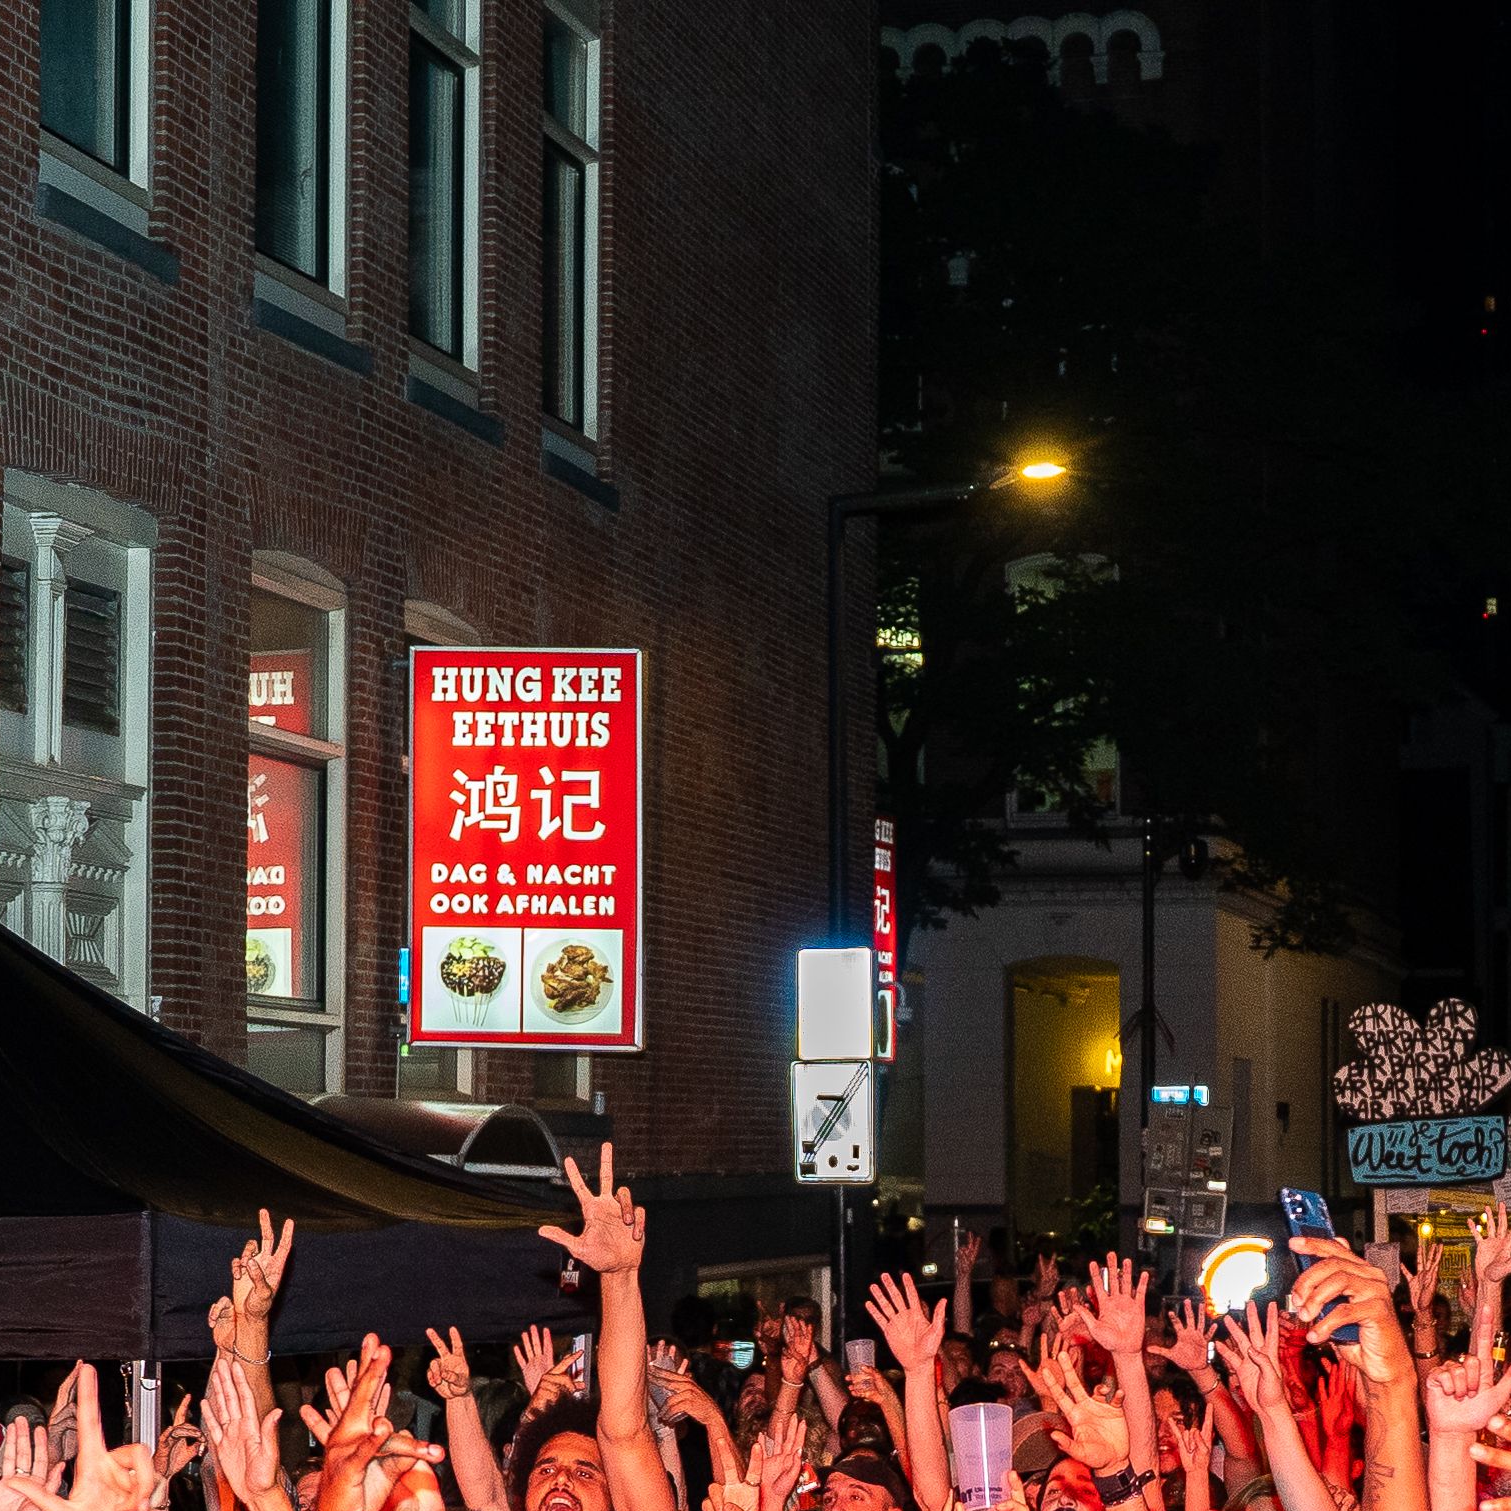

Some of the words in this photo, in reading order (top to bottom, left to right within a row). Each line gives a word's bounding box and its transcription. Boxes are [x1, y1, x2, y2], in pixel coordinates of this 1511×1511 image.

[431, 667, 542, 702] HUNG
[551, 667, 622, 702] KEE
[452, 711, 610, 747] EETHUIS
[449, 764, 606, 843] 鸿记
[430, 863, 487, 884] DAG
[497, 864, 516, 886] &
[526, 864, 616, 885] NACHT
[429, 893, 489, 914] OOK
[495, 894, 615, 916] AFHALEN
